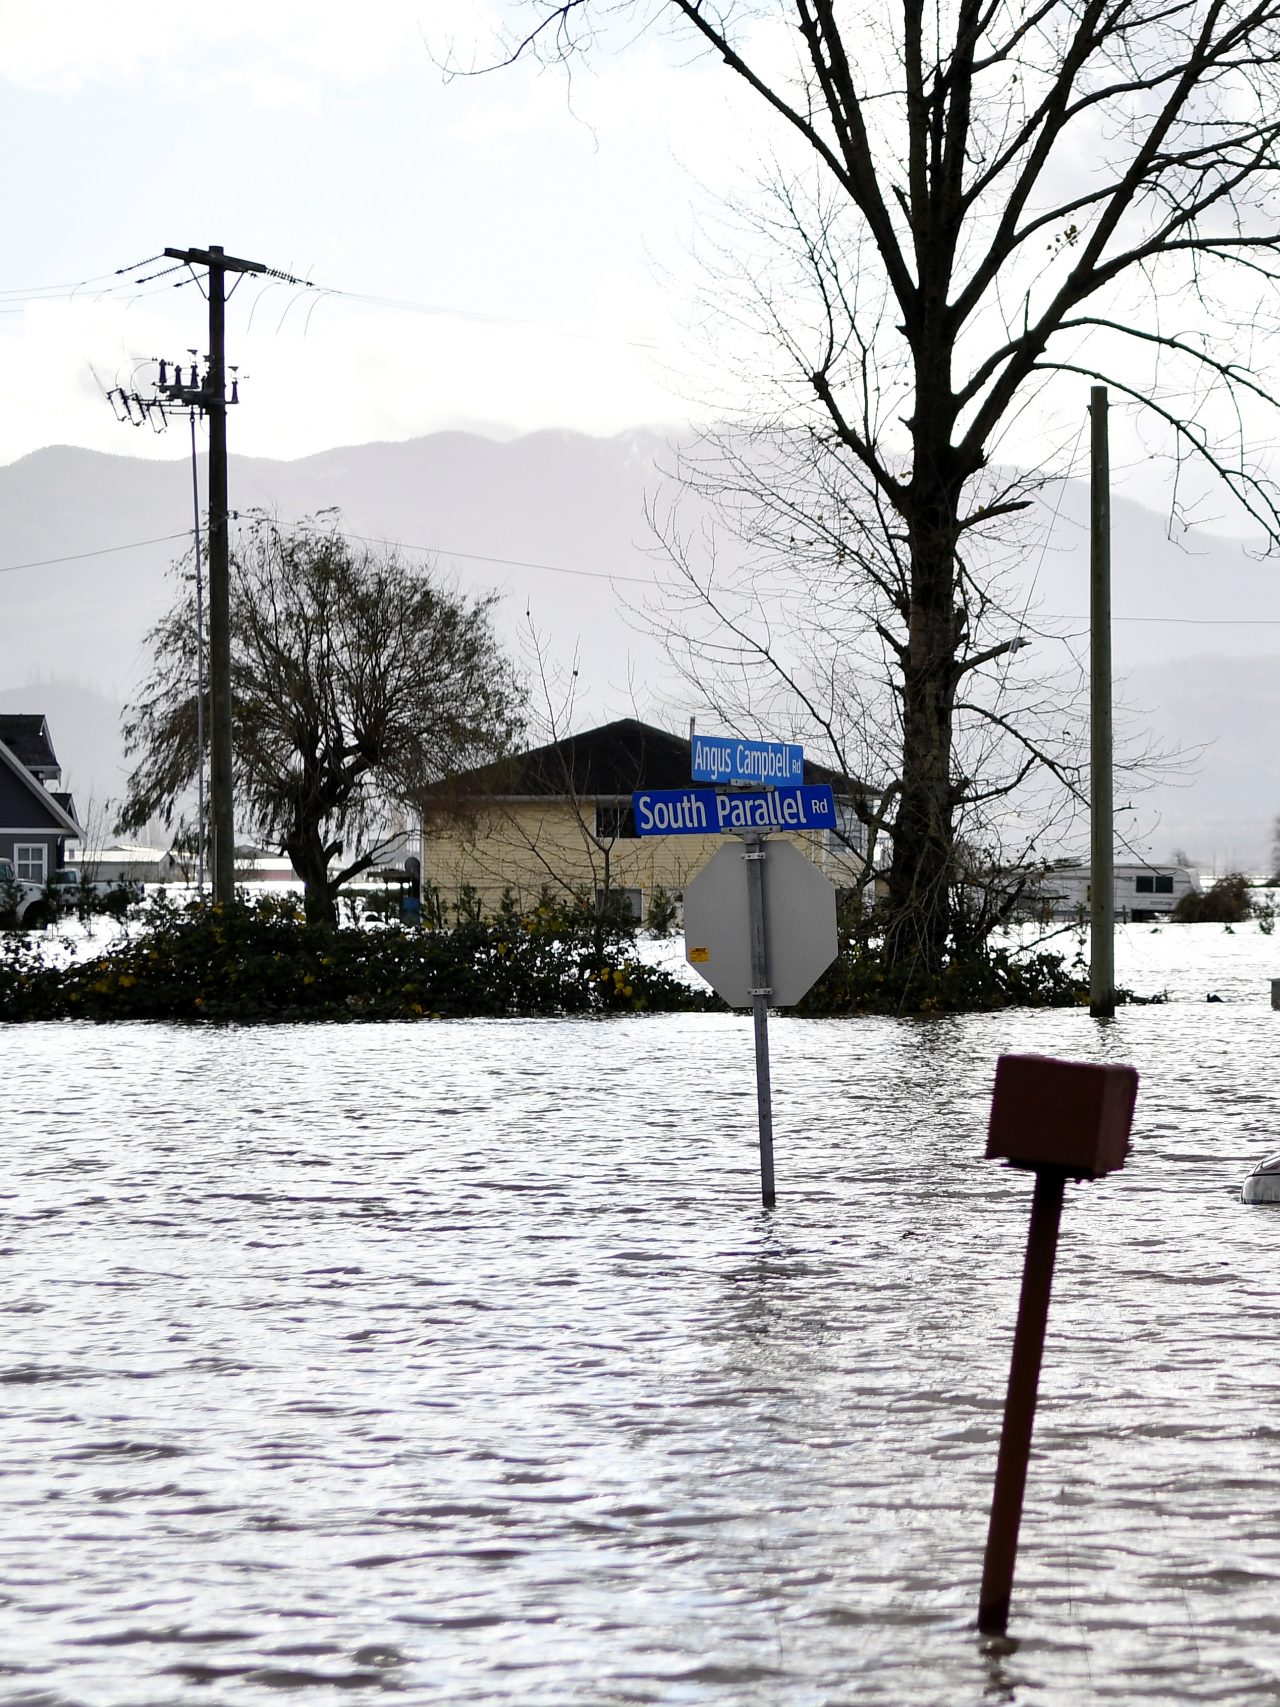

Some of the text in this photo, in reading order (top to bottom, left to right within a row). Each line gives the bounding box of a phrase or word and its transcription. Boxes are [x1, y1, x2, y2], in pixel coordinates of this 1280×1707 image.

[695, 740, 801, 783] Angus Campbell Rd
[639, 791, 829, 830] South Parallel Rd
